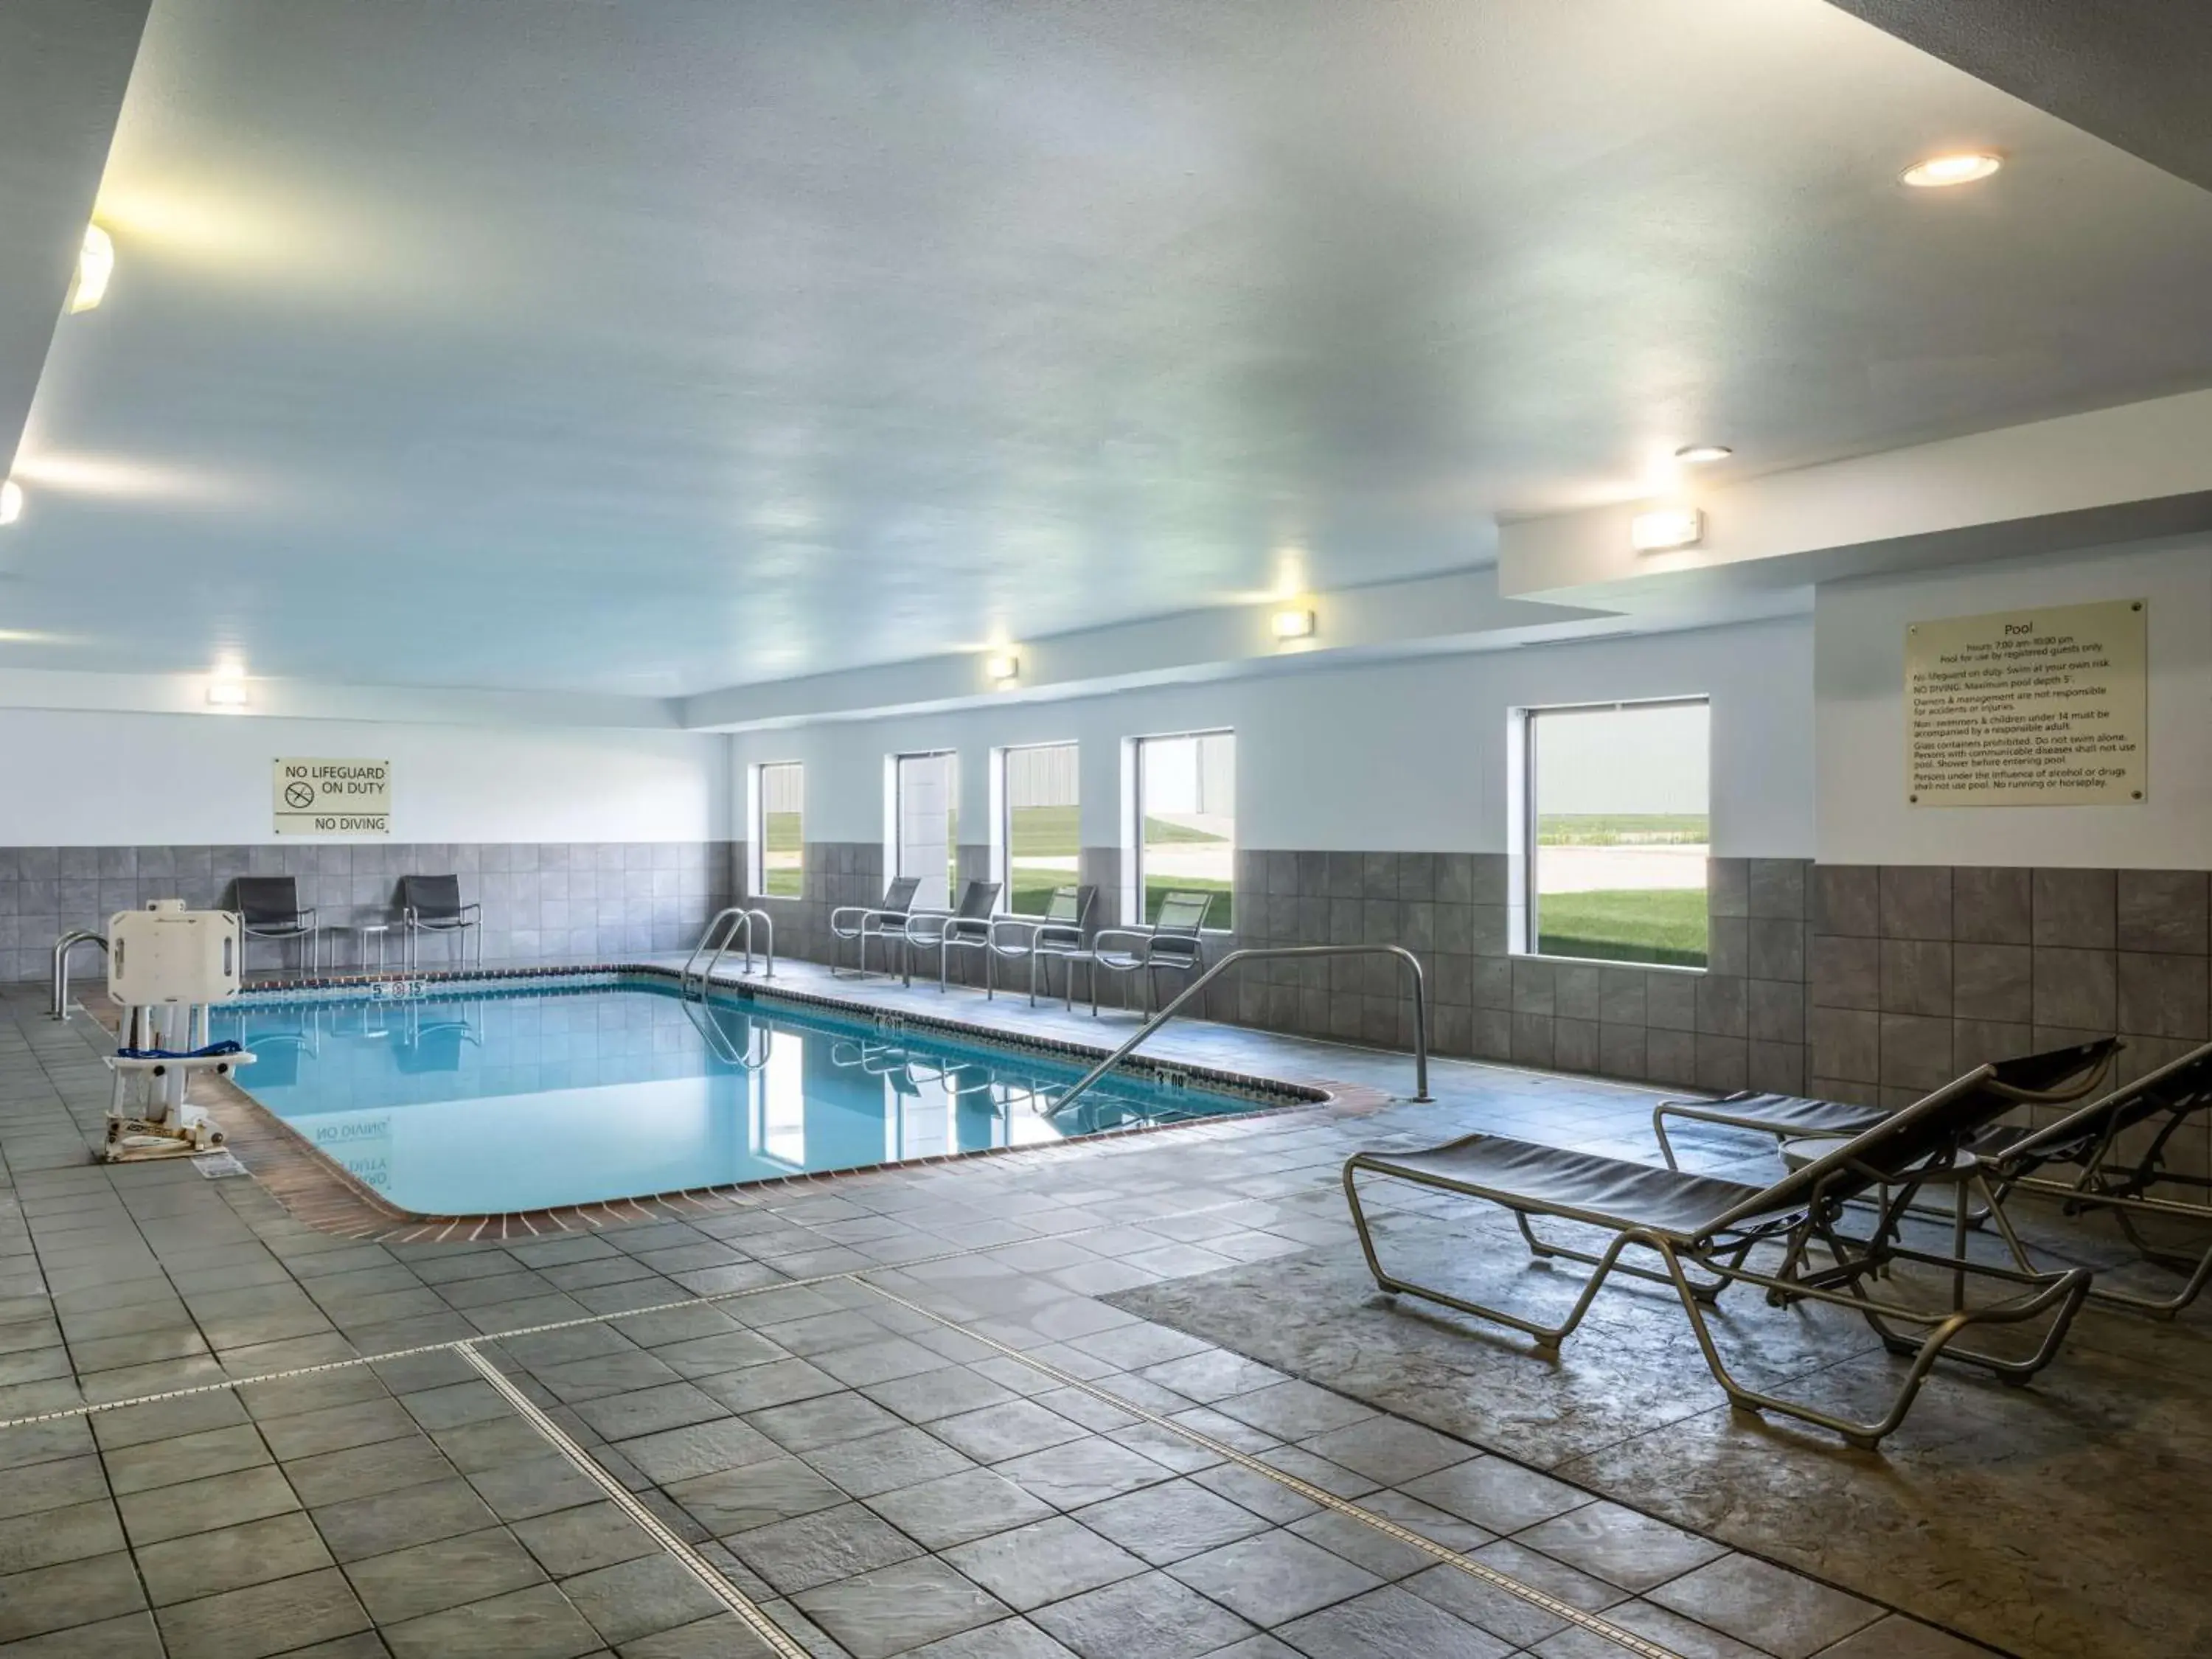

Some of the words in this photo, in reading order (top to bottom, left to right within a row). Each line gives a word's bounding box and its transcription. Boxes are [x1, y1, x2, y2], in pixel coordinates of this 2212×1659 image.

[2005, 622, 2033, 635] Pool
[1940, 654, 1958, 664] Pool
[1960, 653, 1972, 664] for
[1992, 652, 2002, 661] by
[2004, 647, 2048, 660] registered
[2050, 644, 2080, 657] guests
[1927, 671, 1966, 682] lifeguard
[1968, 669, 1980, 678] on
[2006, 664, 2031, 675] Swim
[2033, 664, 2042, 673] at
[2045, 662, 2067, 673] your
[2068, 661, 2091, 670] own
[1913, 686, 1927, 694] NO
[1964, 681, 2008, 691] Maximum
[2011, 678, 2031, 689] pool
[2033, 675, 2062, 686] depth
[1913, 698, 1946, 706] Owners
[1947, 695, 1955, 705] &
[1955, 692, 2014, 706] management
[2017, 692, 2032, 700] are
[2034, 689, 2051, 700] not
[2053, 686, 2107, 701] responsible
[1913, 706, 1926, 717] for
[1928, 705, 1967, 716] accidents
[1969, 705, 1979, 714] or
[1980, 716, 1988, 726] &
[1989, 714, 2027, 726] children
[2028, 713, 2056, 723] under
[2059, 712, 2069, 721] 14
[2070, 711, 2096, 720] must
[2096, 709, 2110, 720] be
[1913, 726, 1969, 738] accompanied
[1971, 726, 1982, 737] by
[1992, 723, 2043, 736] responsible
[1913, 742, 1935, 751] Glass
[1936, 740, 1982, 751] containers
[2034, 737, 2049, 745] Do
[2051, 735, 2067, 745] not
[2069, 734, 2096, 743] swim
[1913, 751, 1946, 759] Persons
[1947, 750, 1966, 759] with
[1968, 747, 2034, 758] communicable
[2034, 745, 2073, 755] diseases
[2074, 744, 2097, 754] shall
[2098, 744, 2117, 752] not
[2118, 742, 2136, 751] use
[1937, 759, 1968, 768] Shower
[1971, 758, 2000, 767] before
[2002, 757, 2042, 767] entering
[285, 766, 307, 778] NO
[312, 766, 386, 779] LIFEGUARD
[1913, 773, 1946, 782] Persons
[1947, 772, 1973, 780] under
[1975, 771, 1991, 779] the
[1992, 770, 2034, 779] influence
[2036, 769, 2047, 778] of
[2048, 768, 2083, 778] alcohol
[2084, 768, 2097, 777] or
[2098, 767, 2126, 779] drugs
[321, 782, 343, 794] ON
[347, 782, 386, 794] DUTY
[1913, 782, 1933, 791] shall
[1935, 782, 1951, 790] not
[1952, 782, 1967, 790] use
[1992, 779, 2007, 790] No
[2008, 778, 2045, 790] running
[2046, 778, 2058, 787] or
[315, 818, 336, 830] NO
[340, 818, 385, 830] DIVING
